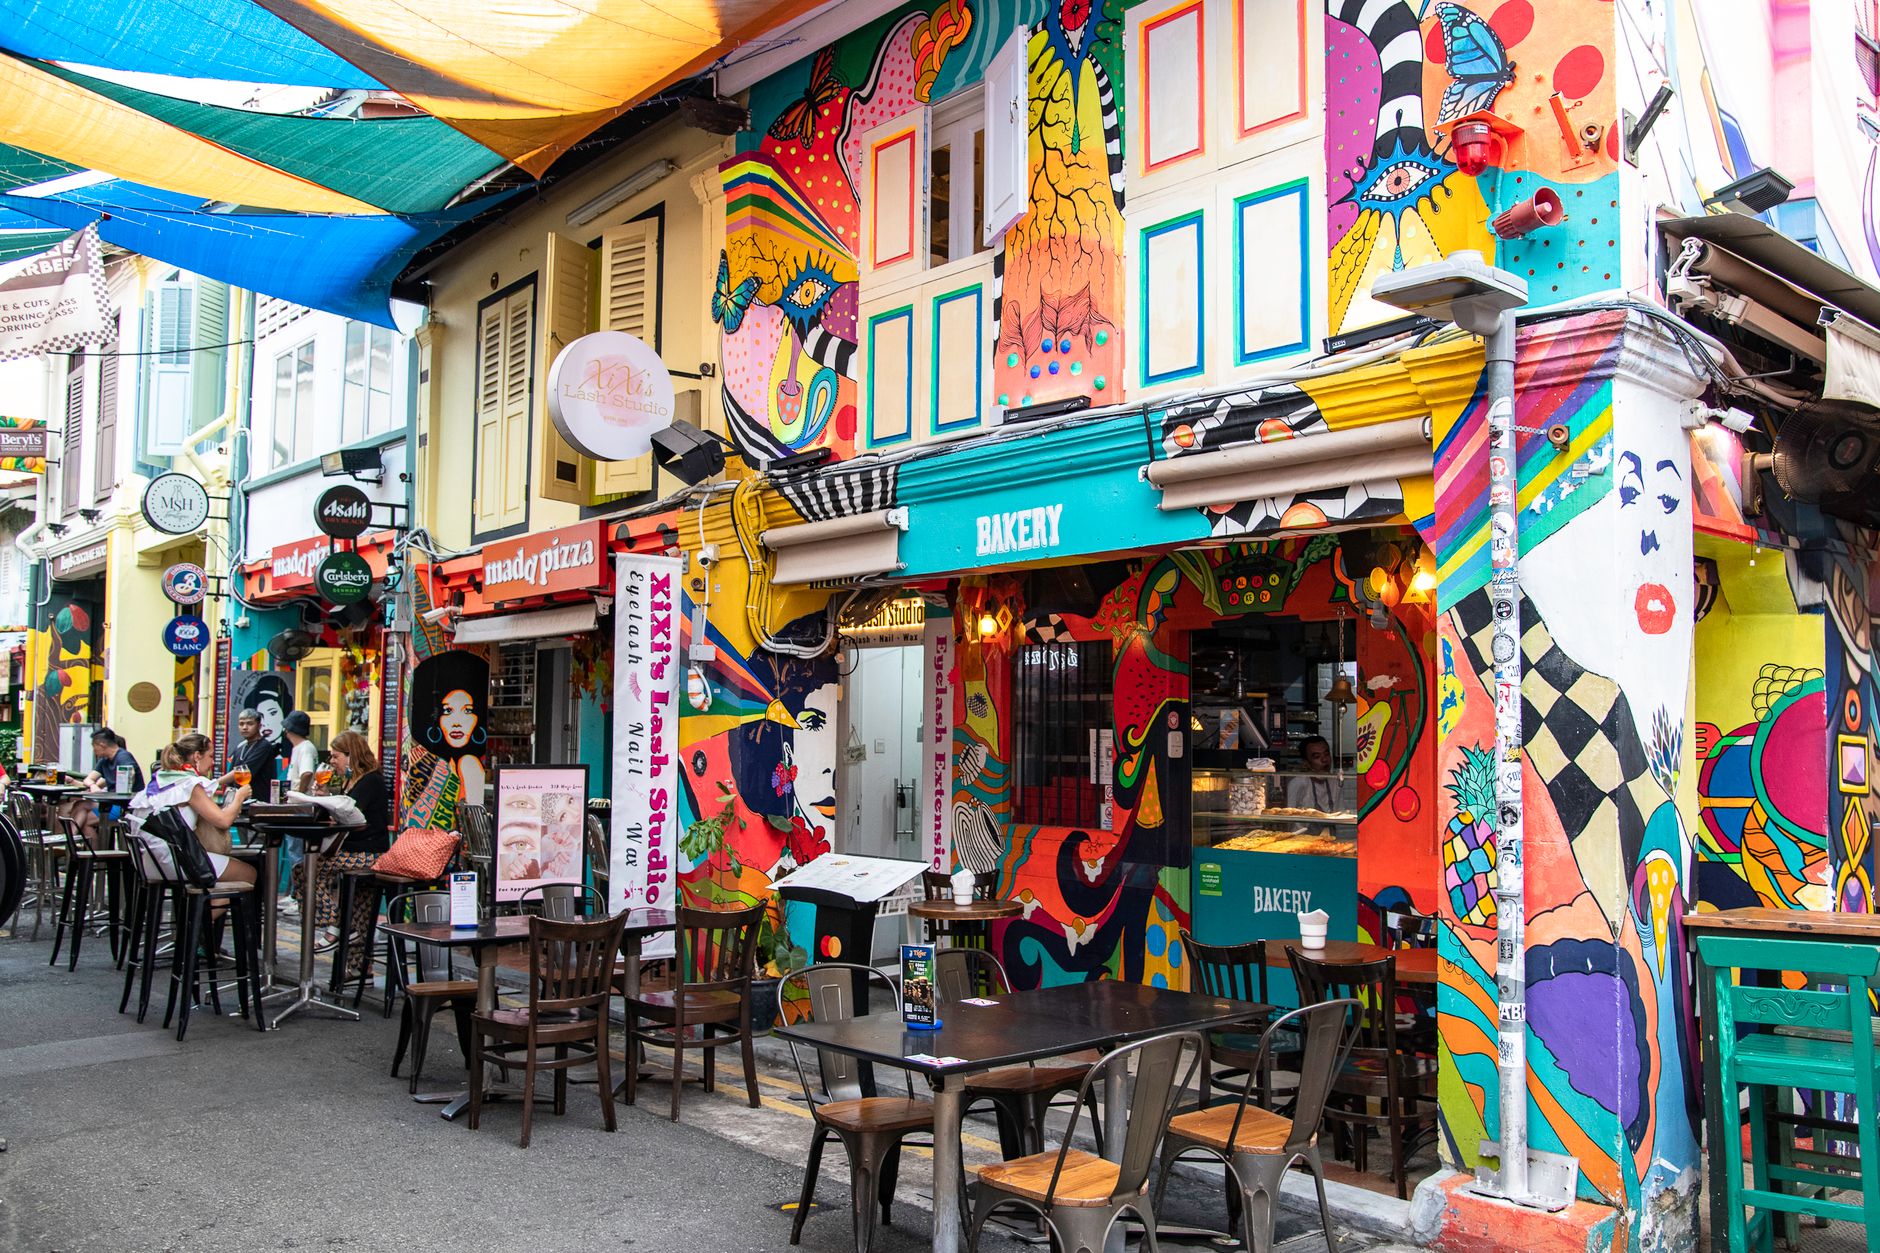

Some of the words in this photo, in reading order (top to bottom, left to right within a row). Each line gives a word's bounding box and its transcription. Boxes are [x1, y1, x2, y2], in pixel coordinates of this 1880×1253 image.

[1, 311, 45, 323] ORKING
[23, 299, 50, 309] CUTS
[0, 321, 41, 333] ORKING
[578, 359, 654, 397] XiXi's
[563, 384, 606, 404] Lash
[612, 394, 668, 417] Studio
[0, 432, 42, 447] Beryl's
[161, 496, 194, 512] MSH
[323, 500, 367, 518] Asahi
[976, 503, 1063, 557] BAKERY
[322, 568, 370, 587] Carlsberg
[539, 537, 595, 586] pizza
[626, 570, 645, 664] Eyelash
[650, 571, 673, 681] XiXi's
[888, 599, 924, 627] Studio
[172, 642, 202, 651] BLANC
[879, 633, 894, 643] Nail
[902, 632, 918, 642] Wax
[933, 634, 948, 744] Eyelash
[628, 722, 644, 775] Nail
[650, 689, 670, 778] Lash
[410, 753, 437, 787] SOUL
[932, 751, 947, 871] Extensio
[625, 822, 643, 867] Wax
[646, 787, 669, 904] Studio
[1253, 885, 1312, 914] BAKERY
[913, 949, 928, 959] Tiger
